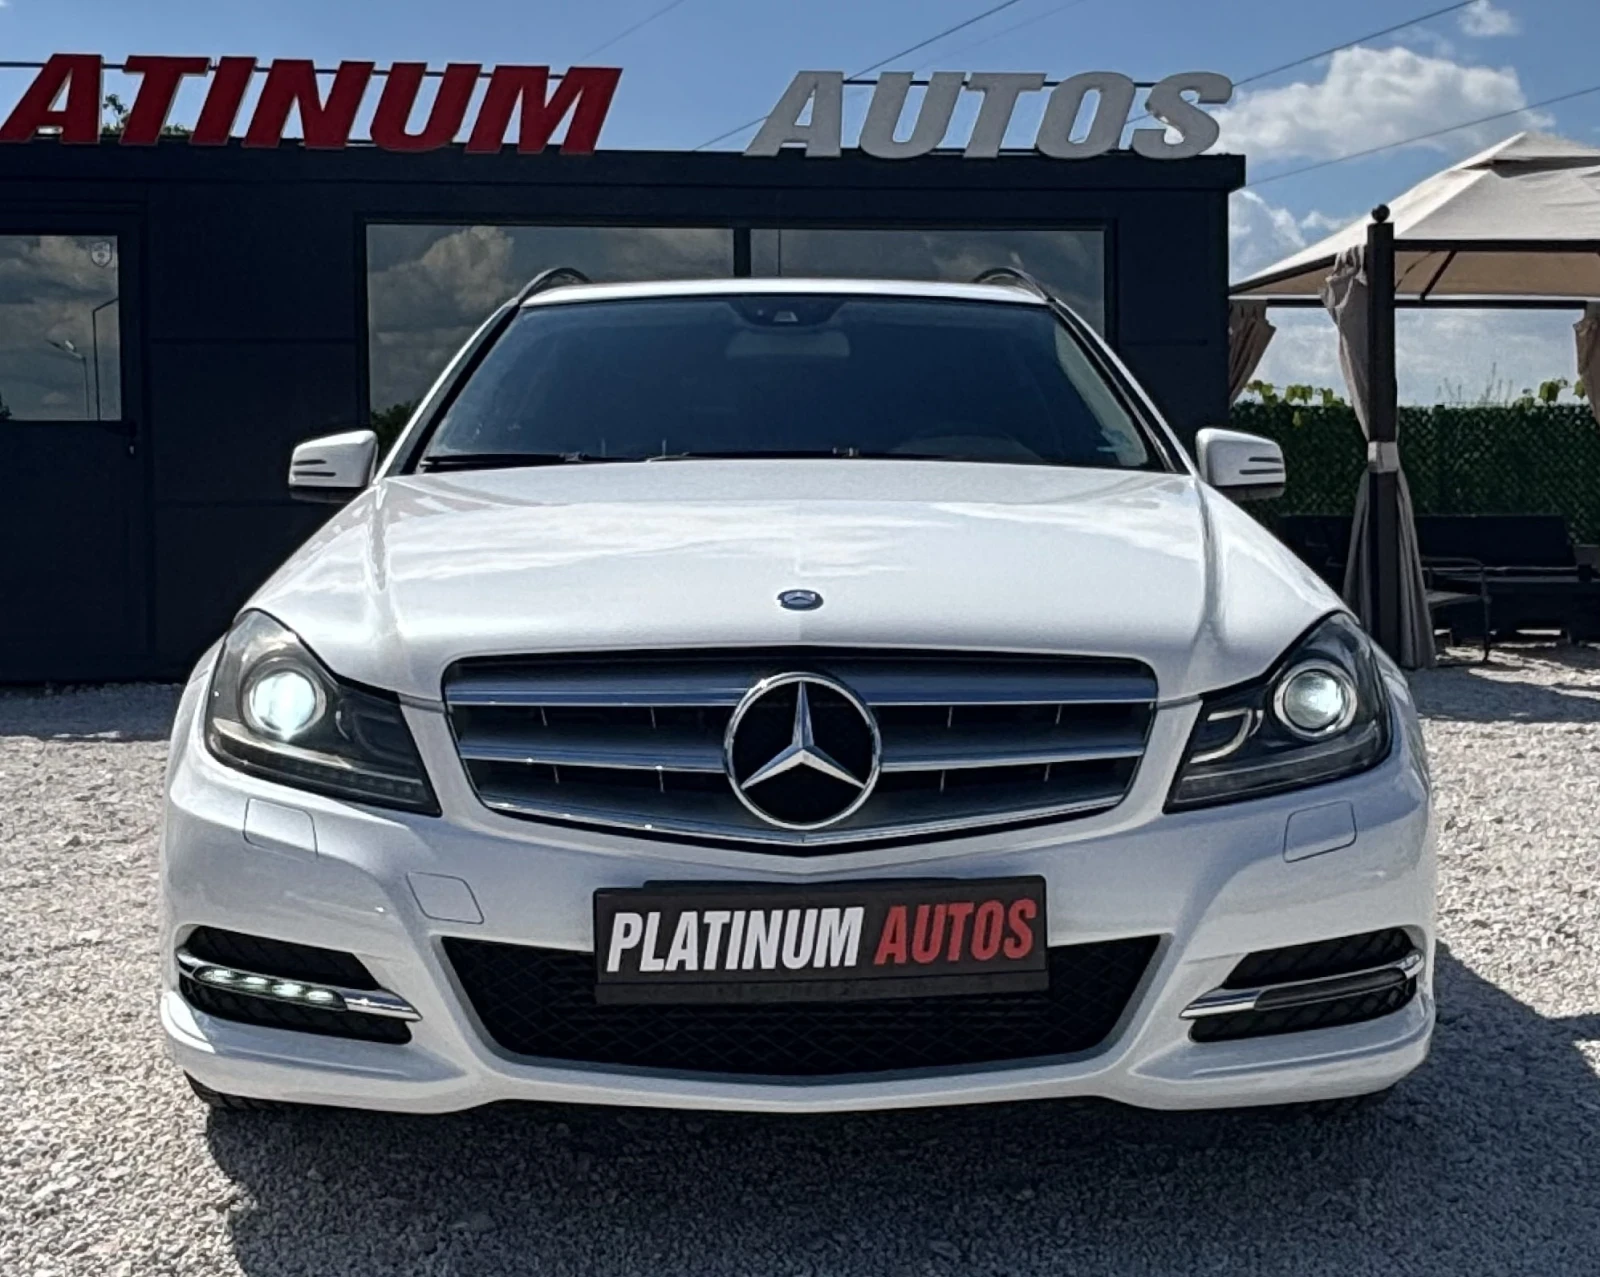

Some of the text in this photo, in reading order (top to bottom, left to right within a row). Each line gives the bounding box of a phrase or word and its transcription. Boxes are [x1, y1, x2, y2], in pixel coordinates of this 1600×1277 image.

[0, 53, 1233, 159] ATINUM AUTOS
[606, 899, 1037, 972] PLATINUM AUTOS
